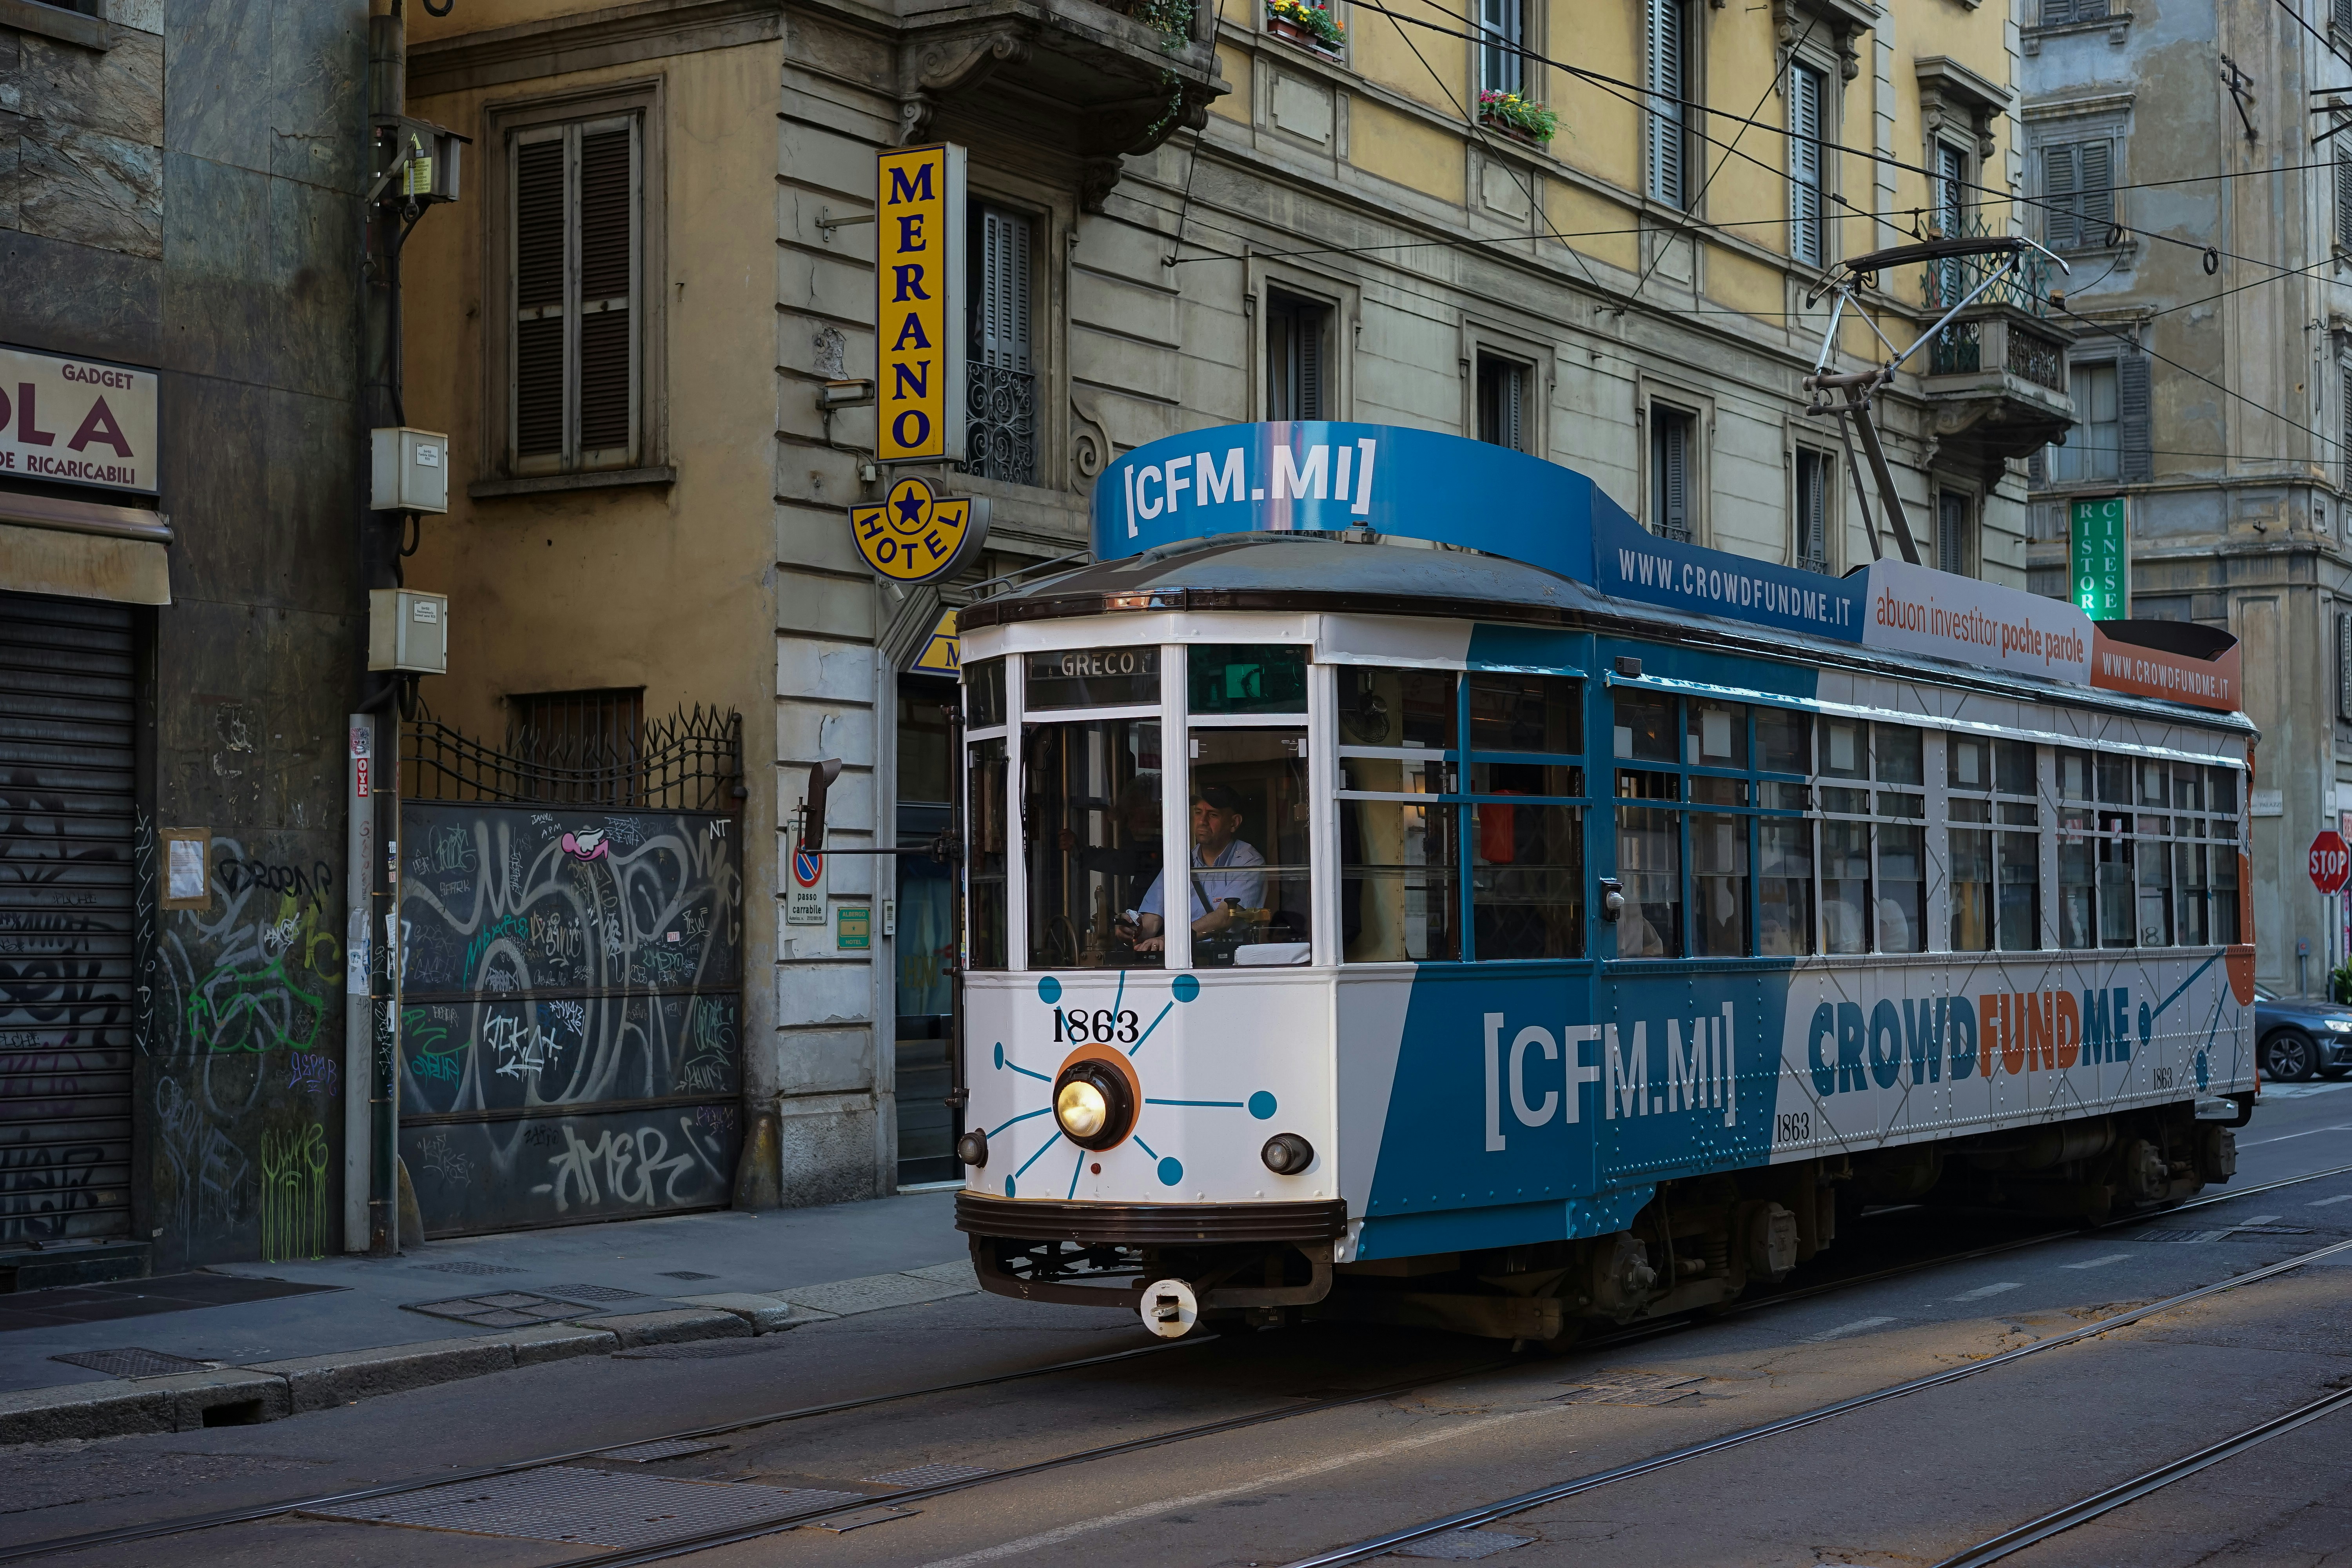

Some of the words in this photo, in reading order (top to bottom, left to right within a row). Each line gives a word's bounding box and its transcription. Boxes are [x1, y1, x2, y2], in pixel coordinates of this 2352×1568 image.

[887, 162, 935, 448] MERANO
[62, 364, 133, 390] GADGET
[27, 454, 134, 485] RICARICABILI
[1124, 438, 1376, 539] [CFM.MI]
[860, 509, 962, 569] HOTEL
[2102, 502, 2117, 608] CINESE
[1619, 548, 1850, 626] WWW.CROWDFUNDME.IT
[1877, 586, 1926, 633] abuon
[1931, 596, 1998, 648] investitor
[2002, 617, 2042, 659] poche
[2045, 632, 2083, 666] parole
[1062, 652, 1134, 676] GRECO
[2102, 652, 2229, 701] WWW.CROWDFUNDME.IT
[358, 759, 367, 795] OYE
[2311, 850, 2347, 875] STOP
[792, 905, 822, 914] carrabile
[798, 893, 817, 902] passo
[1053, 1009, 1139, 1043] 1863
[1808, 987, 2131, 1097] CROWDFUNDME
[1484, 1001, 1736, 1152] [CFM.MI]
[2153, 1067, 2172, 1090] 1863
[1777, 1112, 1809, 1142] 1863
